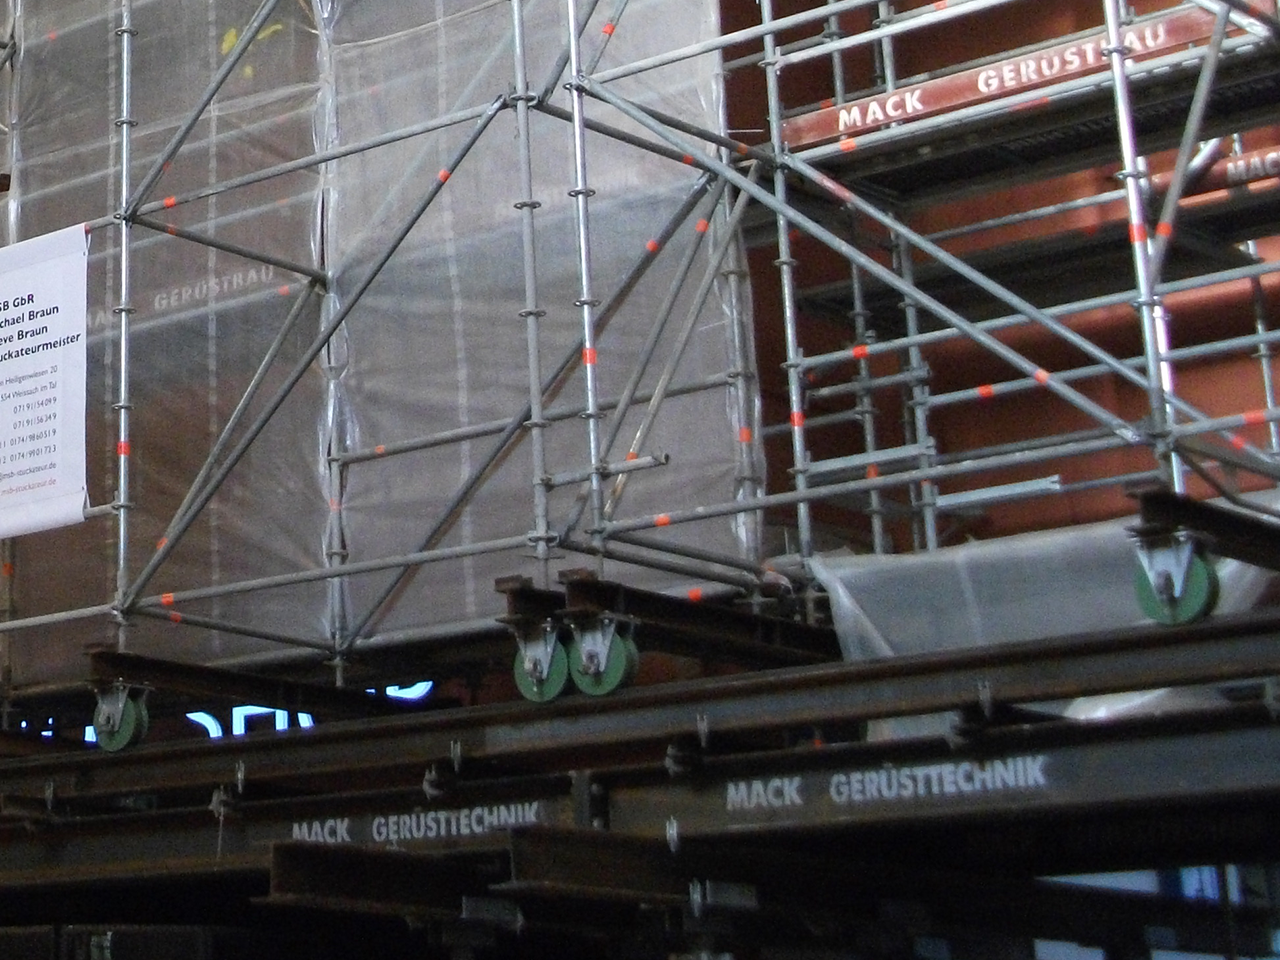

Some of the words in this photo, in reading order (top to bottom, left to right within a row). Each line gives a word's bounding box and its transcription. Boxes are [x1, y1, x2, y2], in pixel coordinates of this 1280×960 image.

[839, 90, 924, 132] MACK
[977, 24, 1166, 93] GERÜSTAU
[1227, 151, 1280, 185] MAC
[13, 293, 35, 308] GbR
[28, 305, 59, 321] Braun
[17, 325, 48, 341] Braun
[726, 777, 802, 812] MACK
[829, 754, 1047, 804] GERÜSTTECHNIK
[292, 816, 350, 844] MACK
[372, 801, 540, 842] GERÜSTTECHNIK
